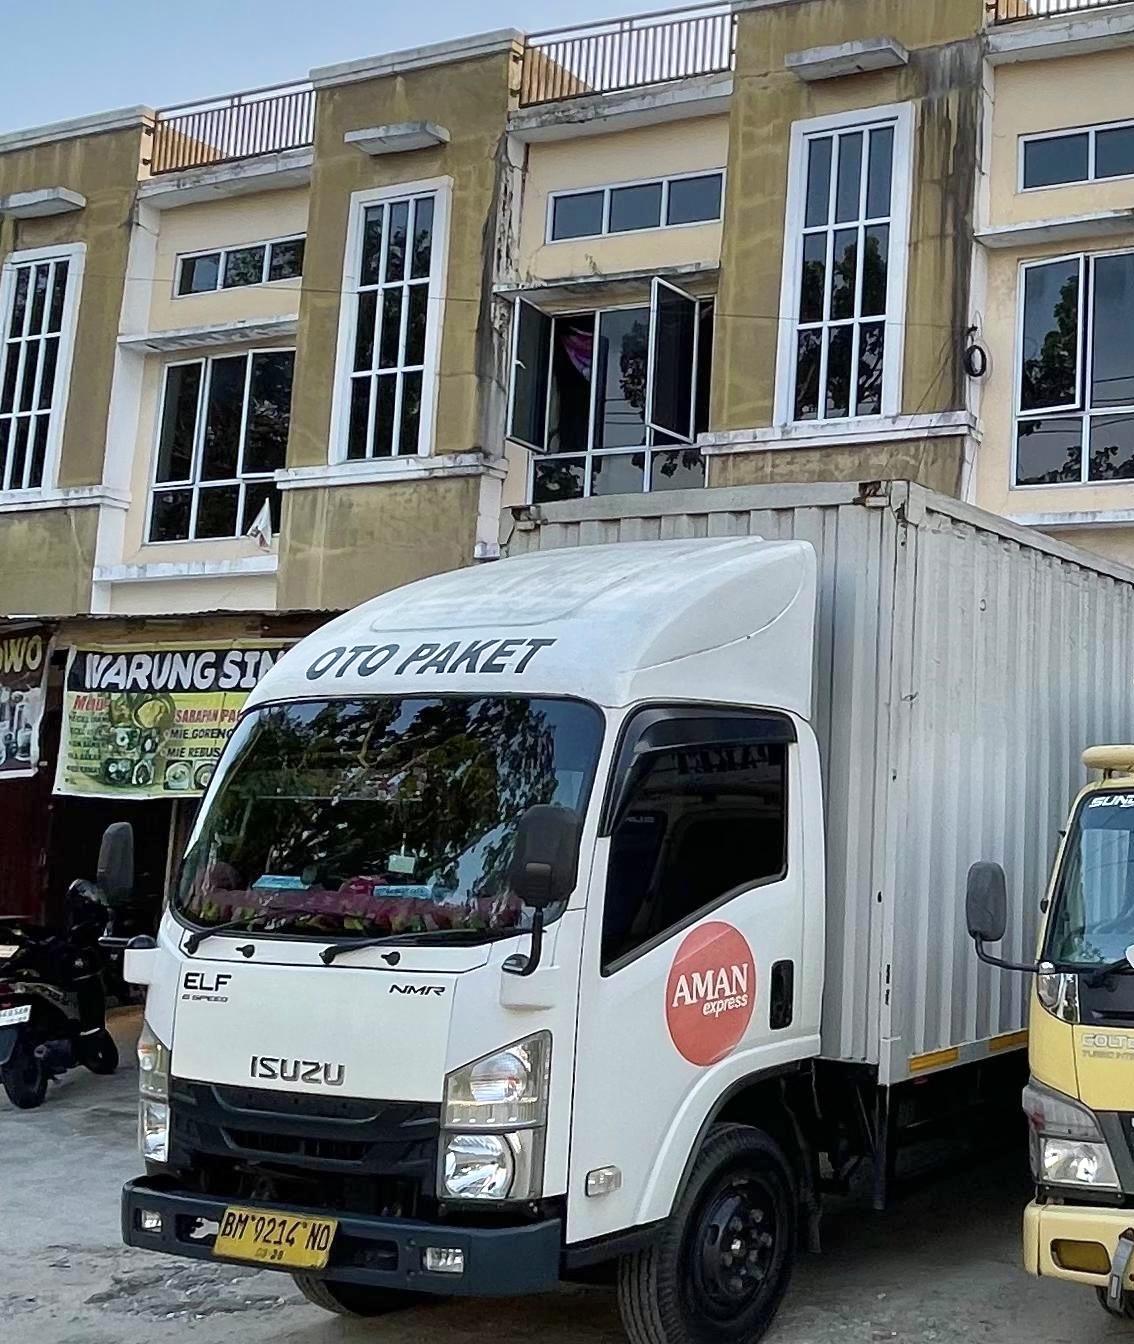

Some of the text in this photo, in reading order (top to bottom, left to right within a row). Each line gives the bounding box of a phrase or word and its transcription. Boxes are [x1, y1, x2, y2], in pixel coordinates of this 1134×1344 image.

[85, 651, 216, 690] WARUNG
[306, 638, 558, 680] OTO PAKET
[184, 972, 231, 992] ELF
[389, 984, 446, 997] NMR
[672, 963, 749, 1008] AMAN
[702, 994, 748, 1017] express
[250, 1056, 345, 1086] ISUZU
[221, 1212, 249, 1240] BM
